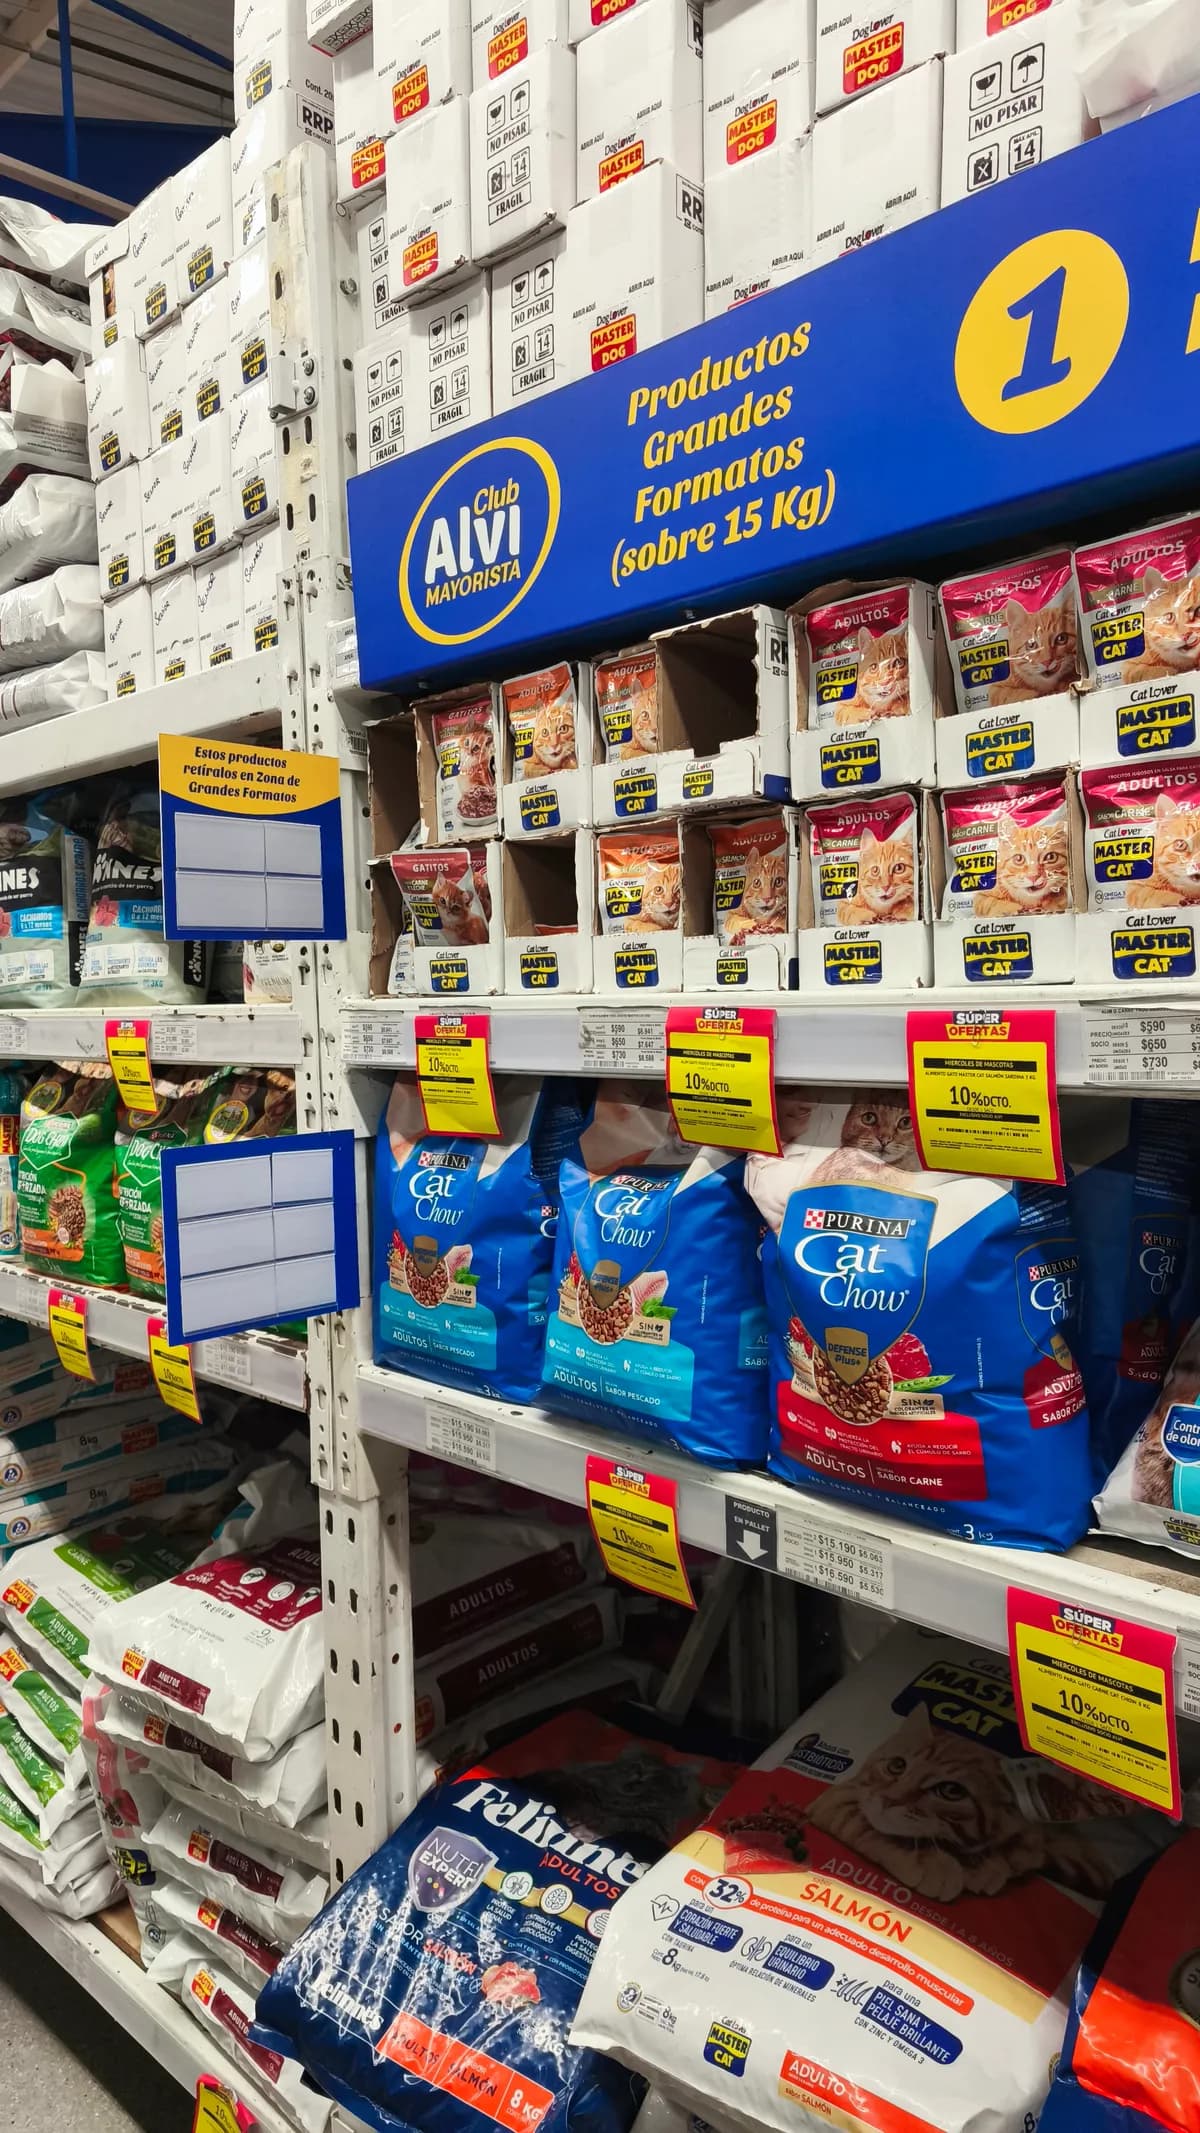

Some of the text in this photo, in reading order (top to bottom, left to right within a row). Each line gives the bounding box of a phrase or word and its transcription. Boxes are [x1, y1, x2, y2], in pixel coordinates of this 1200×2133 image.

[489, 26, 526, 57] MASTER
[845, 30, 900, 68] MASTER
[497, 49, 519, 72] DOG
[857, 58, 889, 85] DOG
[393, 71, 428, 100] MASTER
[402, 96, 422, 116] DOG
[974, 94, 1038, 134] NO PISAR
[302, 106, 334, 134] RRP
[728, 107, 774, 139] MASTER
[490, 121, 526, 152] NO PISAR
[737, 132, 765, 157] DOG
[1014, 142, 1036, 164] 14
[495, 193, 524, 215] FRAGIL
[514, 301, 550, 325] NO PISAR
[591, 321, 634, 350] MASTER
[1001, 266, 1072, 402] 1
[601, 344, 626, 366] DOG
[519, 369, 547, 389] FRAGIL
[627, 321, 812, 426] Productos
[643, 385, 793, 470] Grandes
[634, 437, 805, 524] Formatos
[473, 478, 521, 517] Club
[250, 502, 262, 519] CAT
[610, 468, 836, 587] (sobre 15 Kg)
[425, 558, 521, 608] MAYORISTA
[834, 607, 890, 630] ADULTOS
[1130, 683, 1178, 702] Cat Lover
[1119, 703, 1192, 730] MASTER
[968, 731, 1031, 753] MASTER
[1137, 728, 1172, 749] CAT
[195, 746, 287, 768] Estos productos
[822, 744, 878, 764] MASTER
[984, 752, 1016, 770] CAT
[184, 764, 300, 786] retíralos en Zona de
[836, 767, 863, 784] CAT
[1117, 771, 1199, 792] ADULTOS
[189, 782, 296, 802] Grandes Formatos
[521, 793, 558, 815] MASTER
[1115, 806, 1153, 819] CARNE
[531, 811, 550, 827] CAT
[1096, 838, 1152, 861] MASTER
[412, 862, 449, 873] GATITOS
[1106, 862, 1135, 877] CAT
[1126, 913, 1176, 927] Cat Lover
[965, 939, 1030, 957] MASTER
[1113, 934, 1192, 956] MASTER
[521, 954, 558, 973] MASTER
[981, 962, 1013, 977] CAT
[1133, 958, 1172, 974] CAT
[531, 973, 549, 986] CAT
[440, 1016, 462, 1026] SÚPER
[705, 1008, 737, 1020] SÚPER
[956, 1011, 999, 1024] SÚPER
[436, 1026, 466, 1035] OFERTAS
[698, 1020, 741, 1031] OFERTAS
[950, 1026, 1007, 1035] OFERTAS
[1140, 1021, 1165, 1032] $590
[1141, 1039, 1166, 1050] $650
[1142, 1057, 1168, 1068] $730
[409, 1167, 456, 1199] Cat
[414, 1196, 464, 1226] Chow
[594, 1186, 651, 1219] Cat
[600, 1215, 655, 1248] Chow
[826, 1213, 909, 1236] PURINA
[794, 1232, 888, 1276] Cat
[1038, 1257, 1078, 1277] PURINA
[819, 1272, 906, 1312] Chow
[1030, 1276, 1073, 1311] Cat
[828, 1343, 867, 1357] DEFENSE
[553, 1370, 598, 1392] ADULTOS
[605, 1385, 661, 1406] SABOR PESCADO
[1166, 1431, 1177, 1442] de
[616, 1466, 644, 1483] SÚPER
[806, 1451, 866, 1478] ADULTOS
[612, 1476, 648, 1495] OFERTAS
[877, 1472, 943, 1486] SABOR CARNE
[733, 1501, 770, 1518] PRODUCTO
[745, 1520, 770, 1533] PALLET
[964, 1524, 994, 1541] 3 kg
[818, 1535, 855, 1555] $15.190
[818, 1550, 853, 1569] $15.950
[819, 1566, 853, 1585] $16.590
[448, 1576, 516, 1619] ADULTOS
[1063, 1608, 1112, 1632] SÚPER
[48, 1618, 78, 1648] ADULTOS
[1055, 1619, 1120, 1648] OFERTAS
[1088, 1670, 1097, 1681] DE
[1098, 1673, 1134, 1692] MASCOTAS
[419, 1851, 474, 1889] EXPERT
[539, 1851, 621, 1900] ADULTOS
[690, 1875, 706, 1885] CON
[818, 1857, 913, 1905] ADULTO
[709, 1879, 745, 1903] 32%
[680, 1909, 739, 1939] CORAZÓN FUERTE
[800, 1882, 913, 1944] SALMÓN
[678, 1922, 718, 1945] SALUDABLE
[661, 1948, 678, 1965] 8
[774, 1945, 821, 1971] EQUILIBRIO
[823, 1924, 965, 2007] adecuado desarrollo muscular
[767, 1956, 807, 1980] URINARIO
[874, 1991, 921, 2026] PIEL SANA
[710, 2026, 749, 2054] MASTER
[866, 2002, 951, 2063] PELAJE BRILLANTE
[713, 2050, 733, 2069] CAT
[788, 2061, 846, 2097] ADULTO
[510, 2089, 542, 2121] 8 KG
